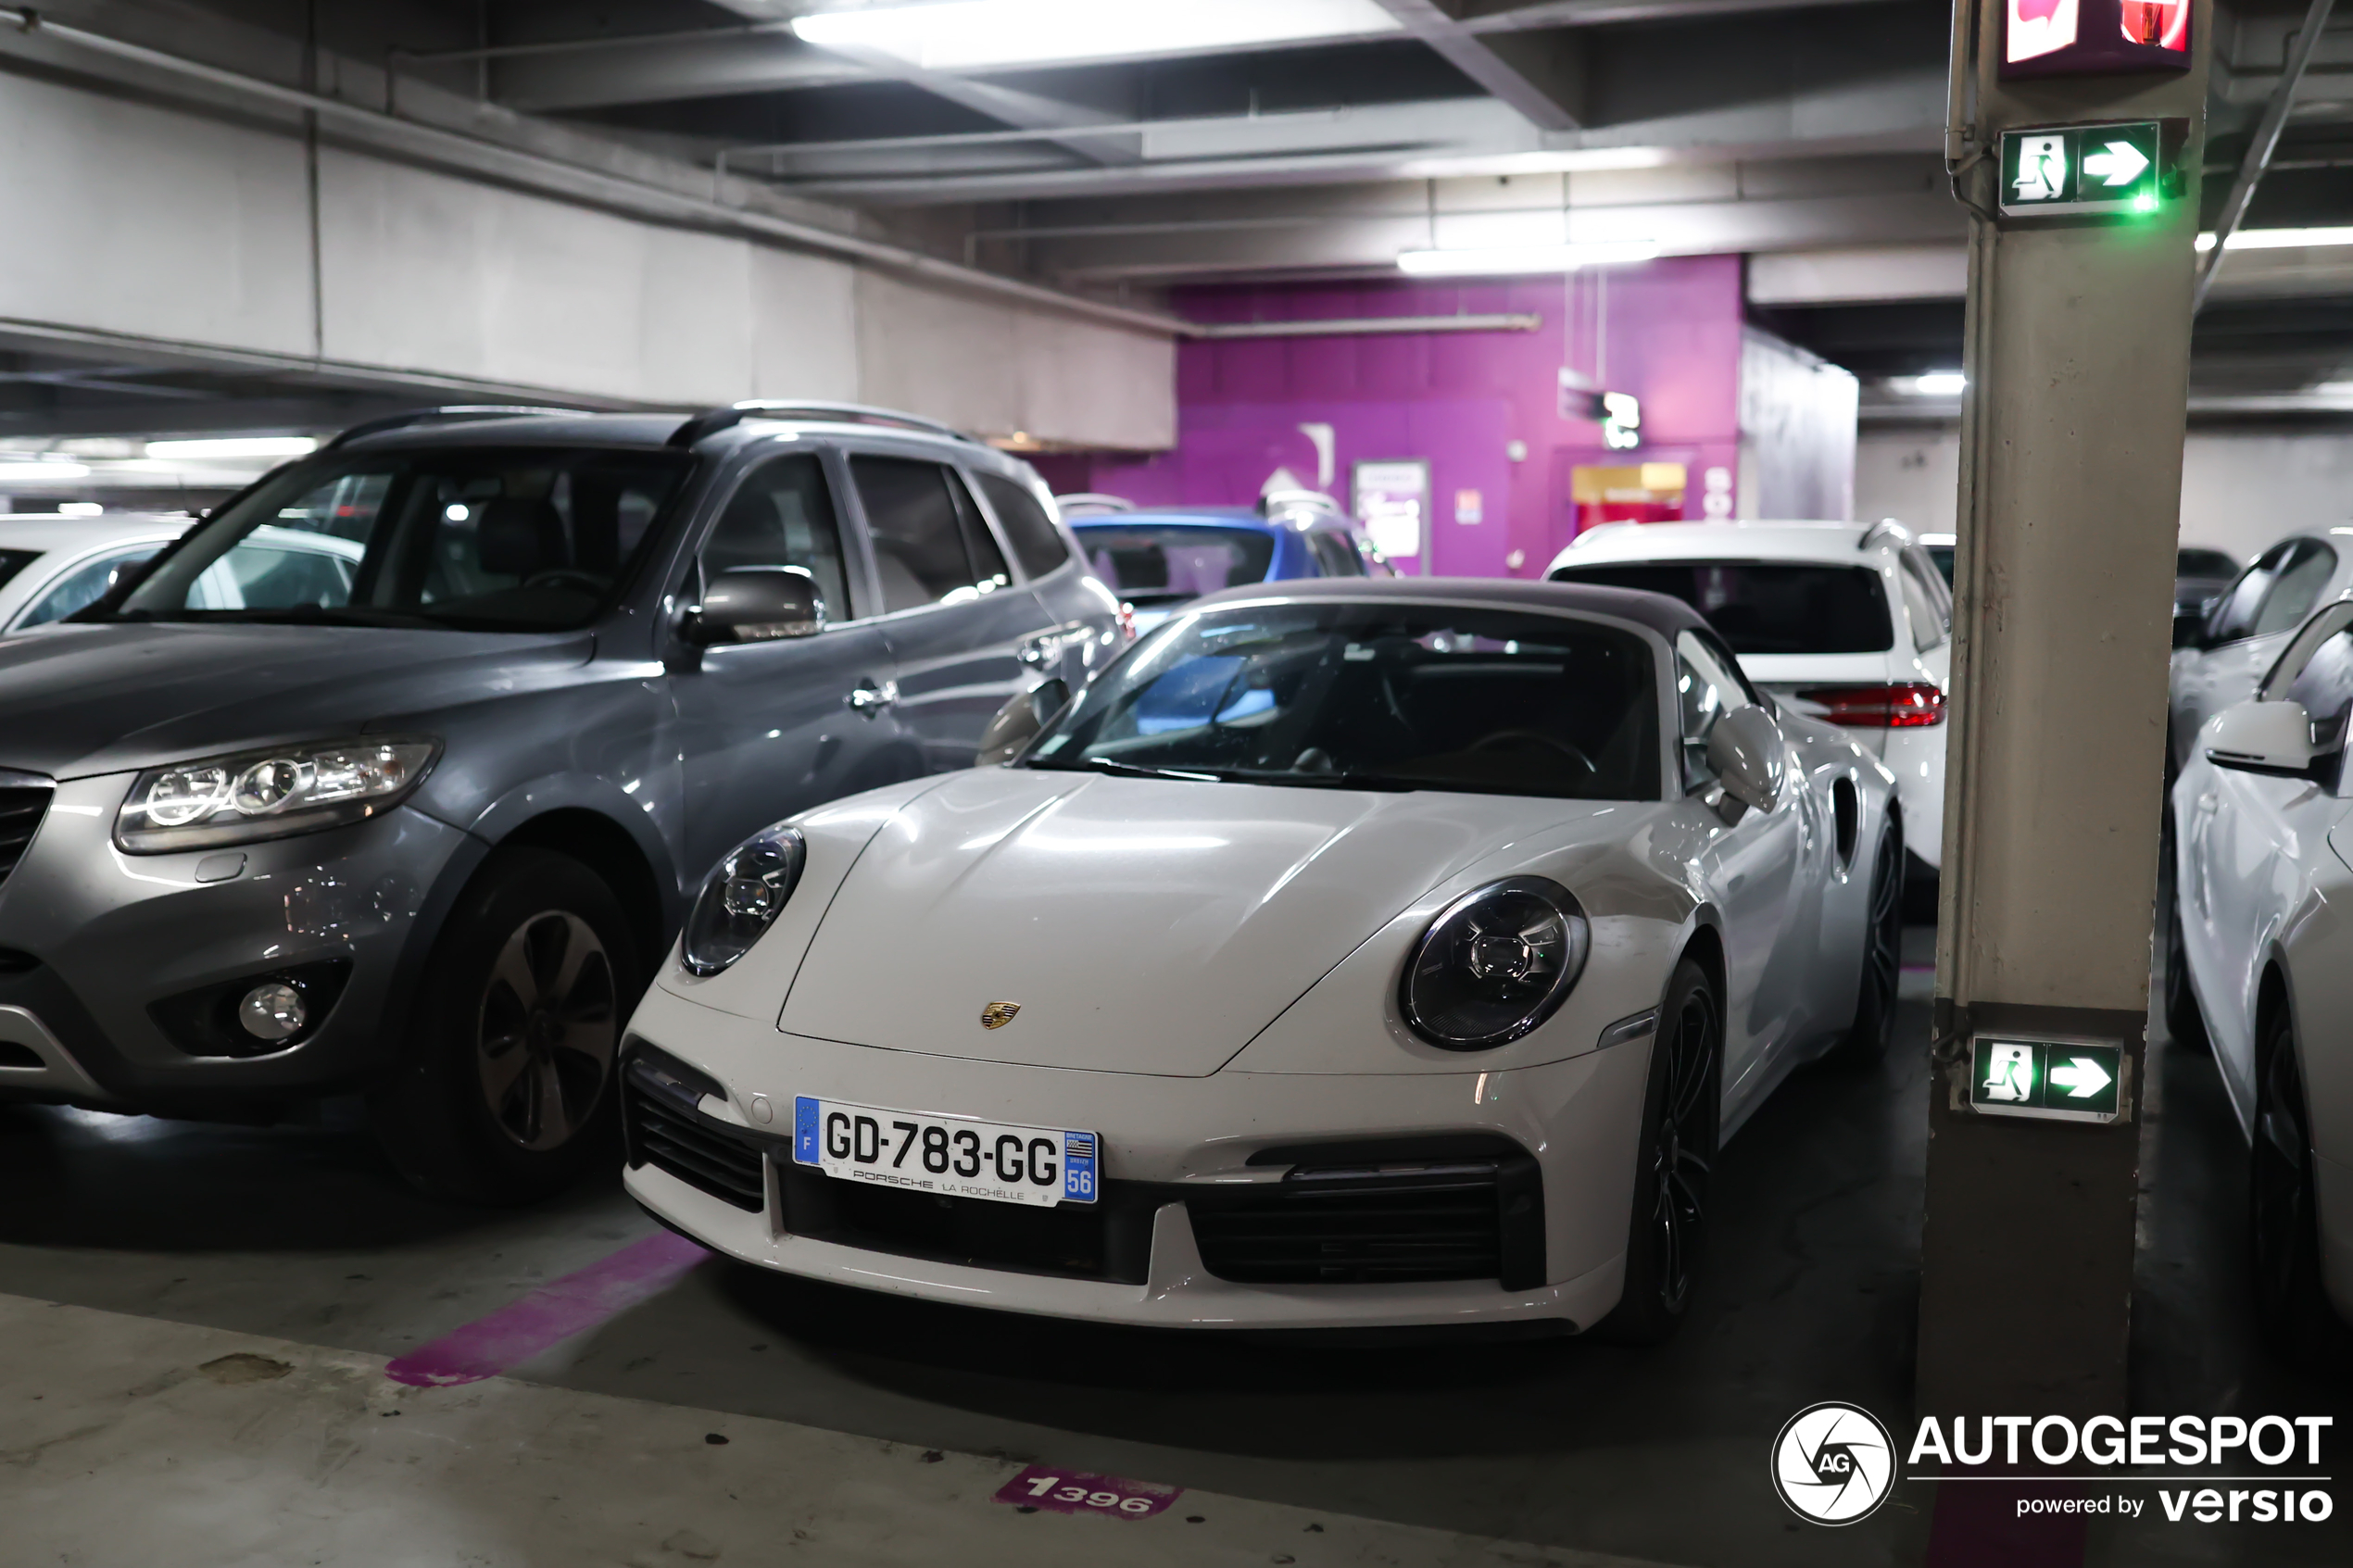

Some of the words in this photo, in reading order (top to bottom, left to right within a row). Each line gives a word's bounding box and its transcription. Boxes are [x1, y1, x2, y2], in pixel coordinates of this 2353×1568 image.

[803, 1136, 812, 1151] F
[826, 1111, 1057, 1186] GD-783-GG
[853, 1171, 934, 1189] PORSCHE
[942, 1184, 957, 1192] LA
[1067, 1169, 1091, 1194] 56
[1026, 1476, 1153, 1512] 1396
